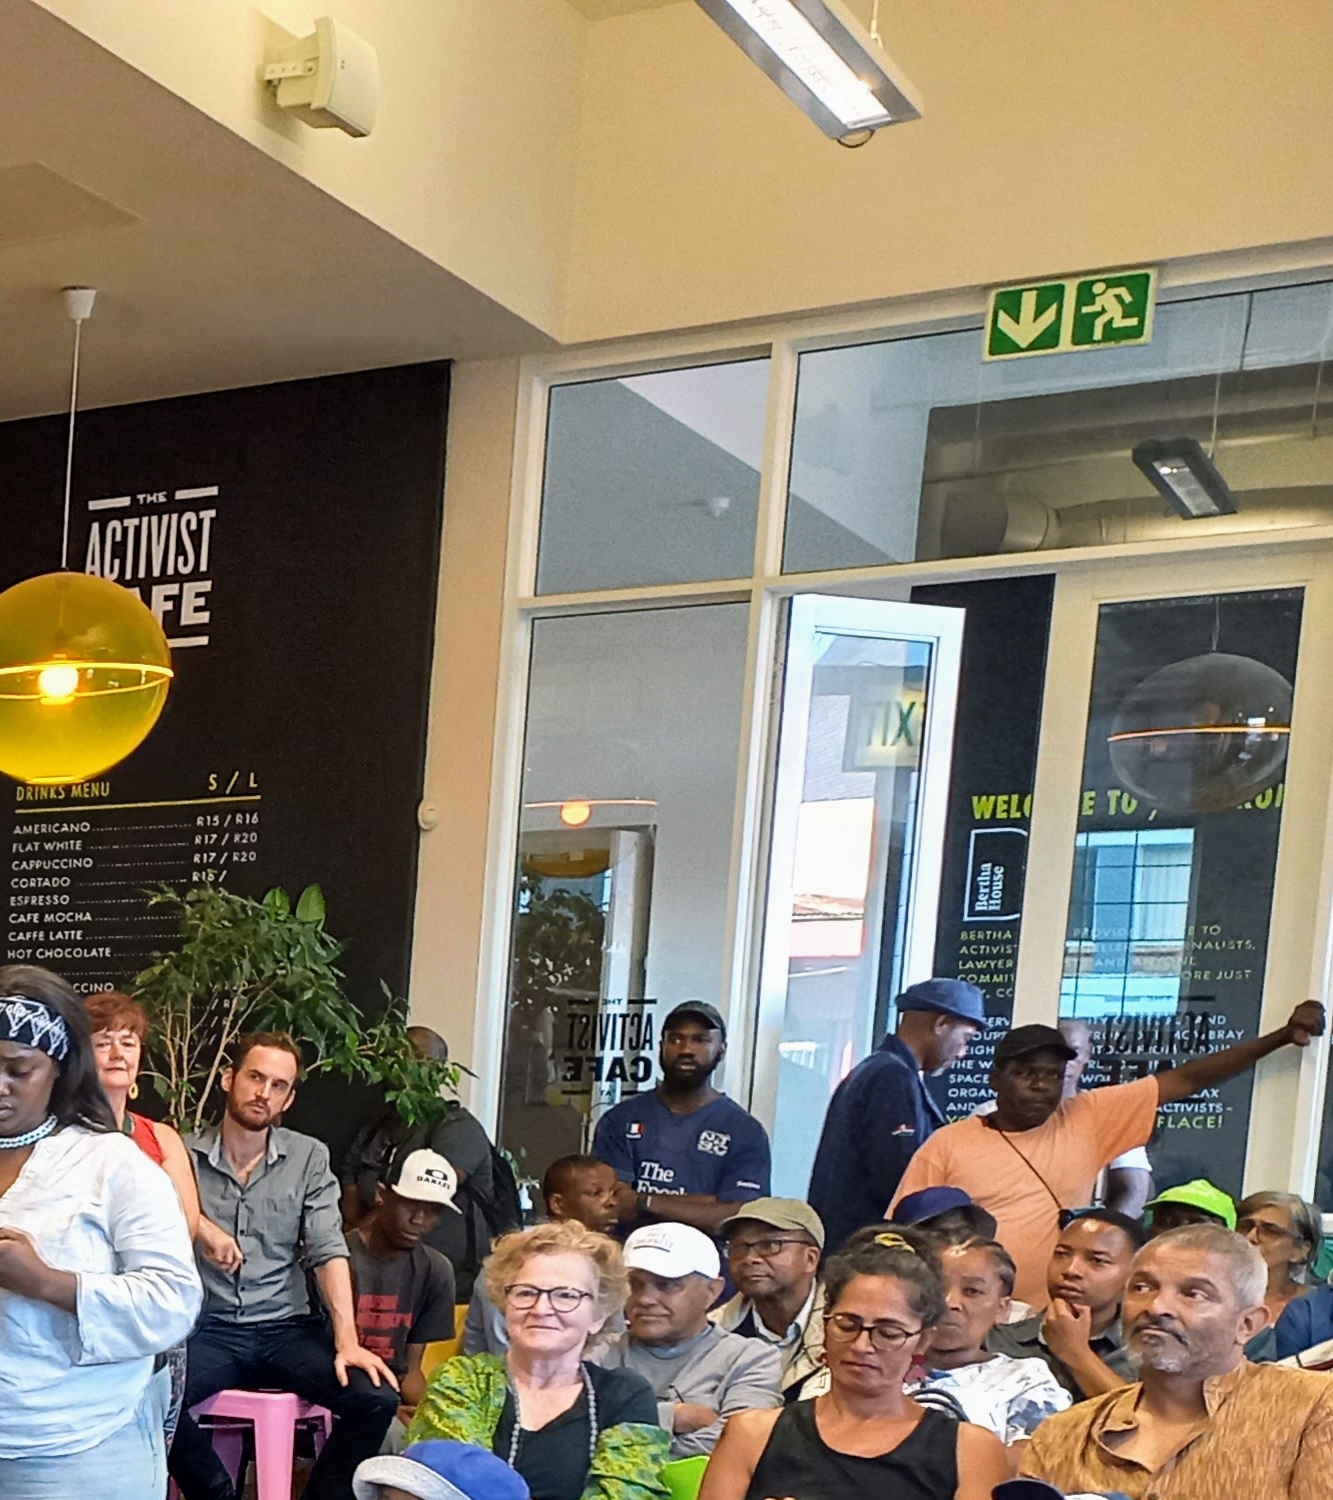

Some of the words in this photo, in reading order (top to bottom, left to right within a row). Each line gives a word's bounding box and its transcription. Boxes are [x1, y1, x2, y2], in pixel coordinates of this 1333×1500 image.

[136, 491, 168, 504] THE
[85, 509, 217, 581] ACTIVIST
[209, 773, 219, 791] S
[249, 771, 259, 788] L
[16, 785, 66, 802] DRINKS
[70, 781, 110, 798] MENU
[196, 815, 220, 827] R15
[235, 811, 259, 825] R16
[13, 822, 91, 835] AMERICANO
[194, 833, 218, 845] R17
[233, 831, 258, 844] R20
[12, 841, 40, 854] FLAT
[43, 839, 83, 852] WHITE
[11, 857, 93, 871] CAPPUCCINO
[193, 852, 217, 864] R17
[232, 850, 257, 862] R20
[10, 876, 71, 889] CORTADO
[974, 862, 993, 912] Bertha
[988, 865, 1005, 912] House
[10, 894, 70, 907] ESPRESSO
[8, 912, 39, 925] CAFE
[43, 911, 93, 923] MOCHA
[8, 930, 45, 942] CAFFE
[49, 929, 84, 941] LATTE
[959, 930, 1013, 941] BERTHA
[1201, 924, 1222, 936] TO
[7, 949, 33, 960] HOT
[35, 946, 112, 959] CHOCOLATE
[959, 943, 1018, 955] ACTIVIS
[958, 959, 1014, 970] LAWYER
[1215, 969, 1253, 981] JUST
[72, 982, 115, 994] CCINO
[947, 1087, 999, 1099] ORGAN
[640, 1161, 675, 1183] The
